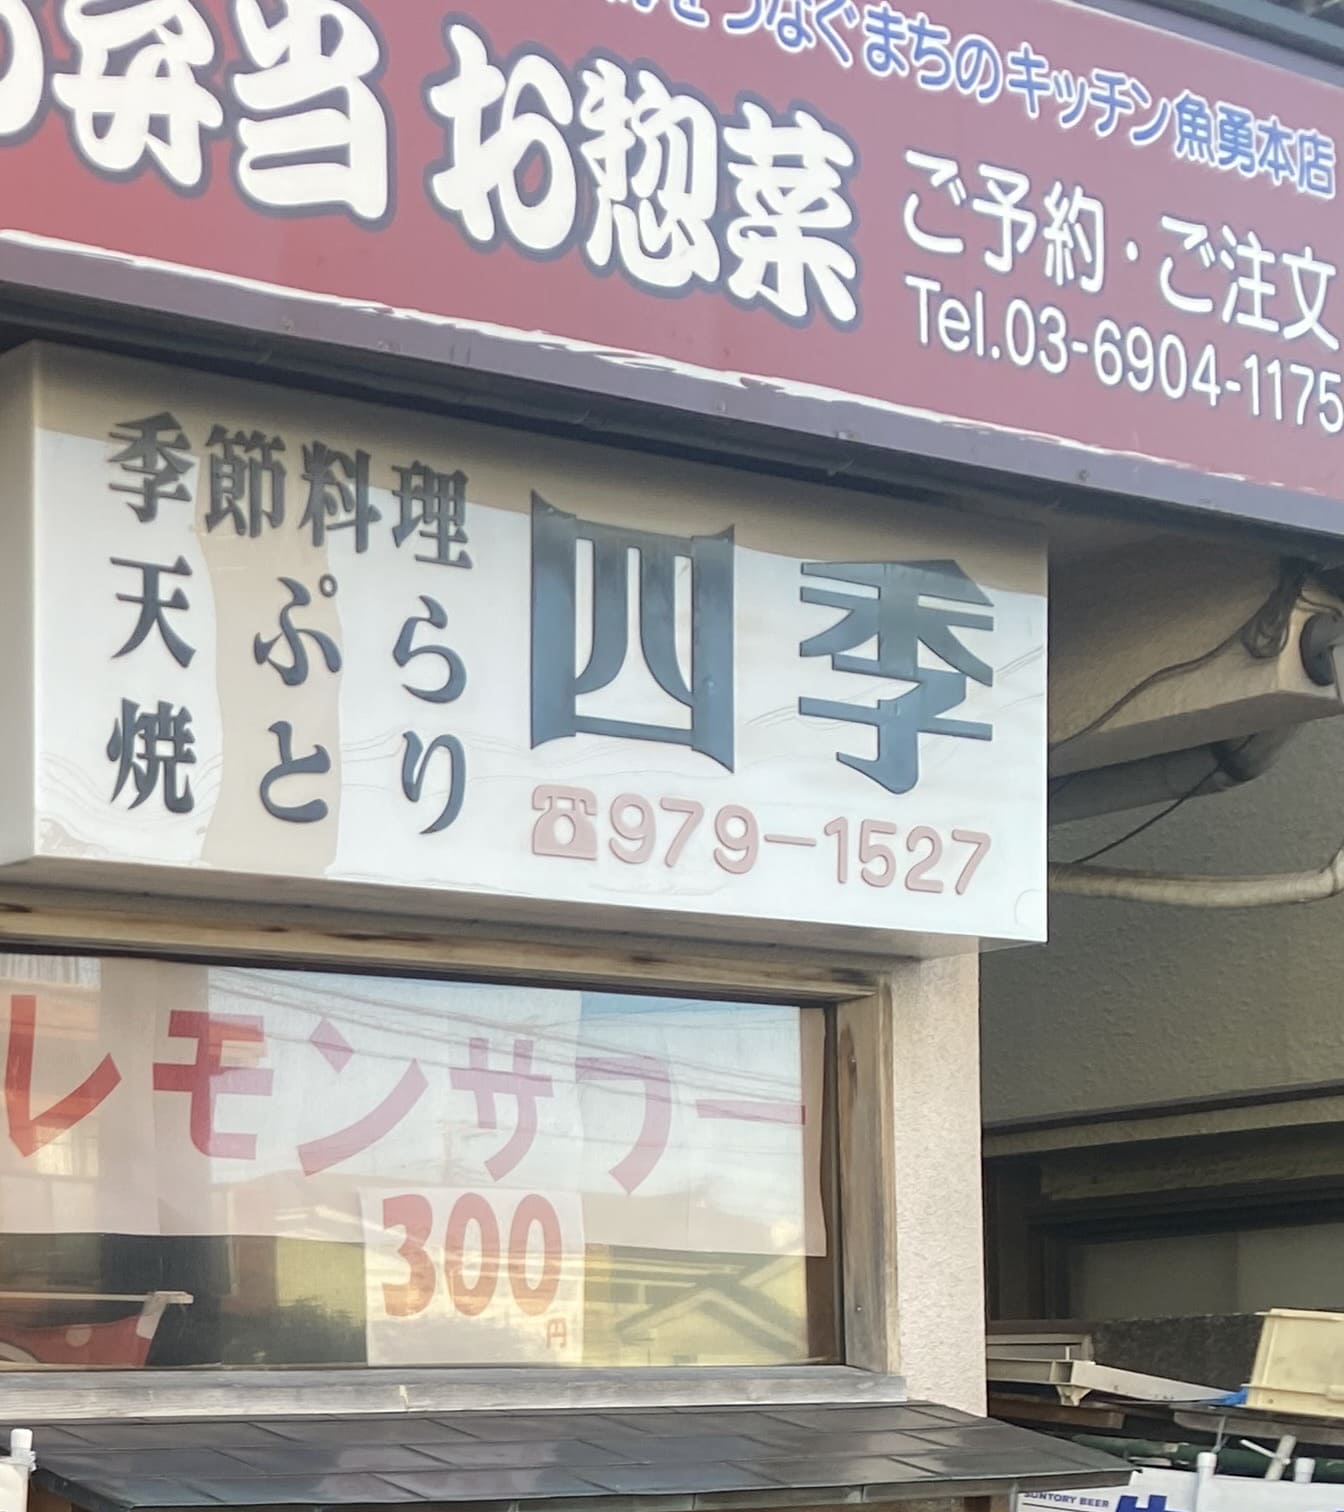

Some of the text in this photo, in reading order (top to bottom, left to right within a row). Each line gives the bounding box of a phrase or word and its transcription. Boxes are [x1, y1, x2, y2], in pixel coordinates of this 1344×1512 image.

[428, 55, 859, 323] お惣菜
[903, 149, 1340, 354] ご予約・ご注文
[903, 274, 1344, 433] Tel.03-6904-1175
[107, 411, 473, 571] 季節料理
[107, 555, 470, 705] 天ぷら
[529, 488, 994, 794] 四季
[104, 698, 470, 837] 焼とり
[380, 1190, 562, 1319] 300
[1079, 1497, 1110, 1509] BEER
